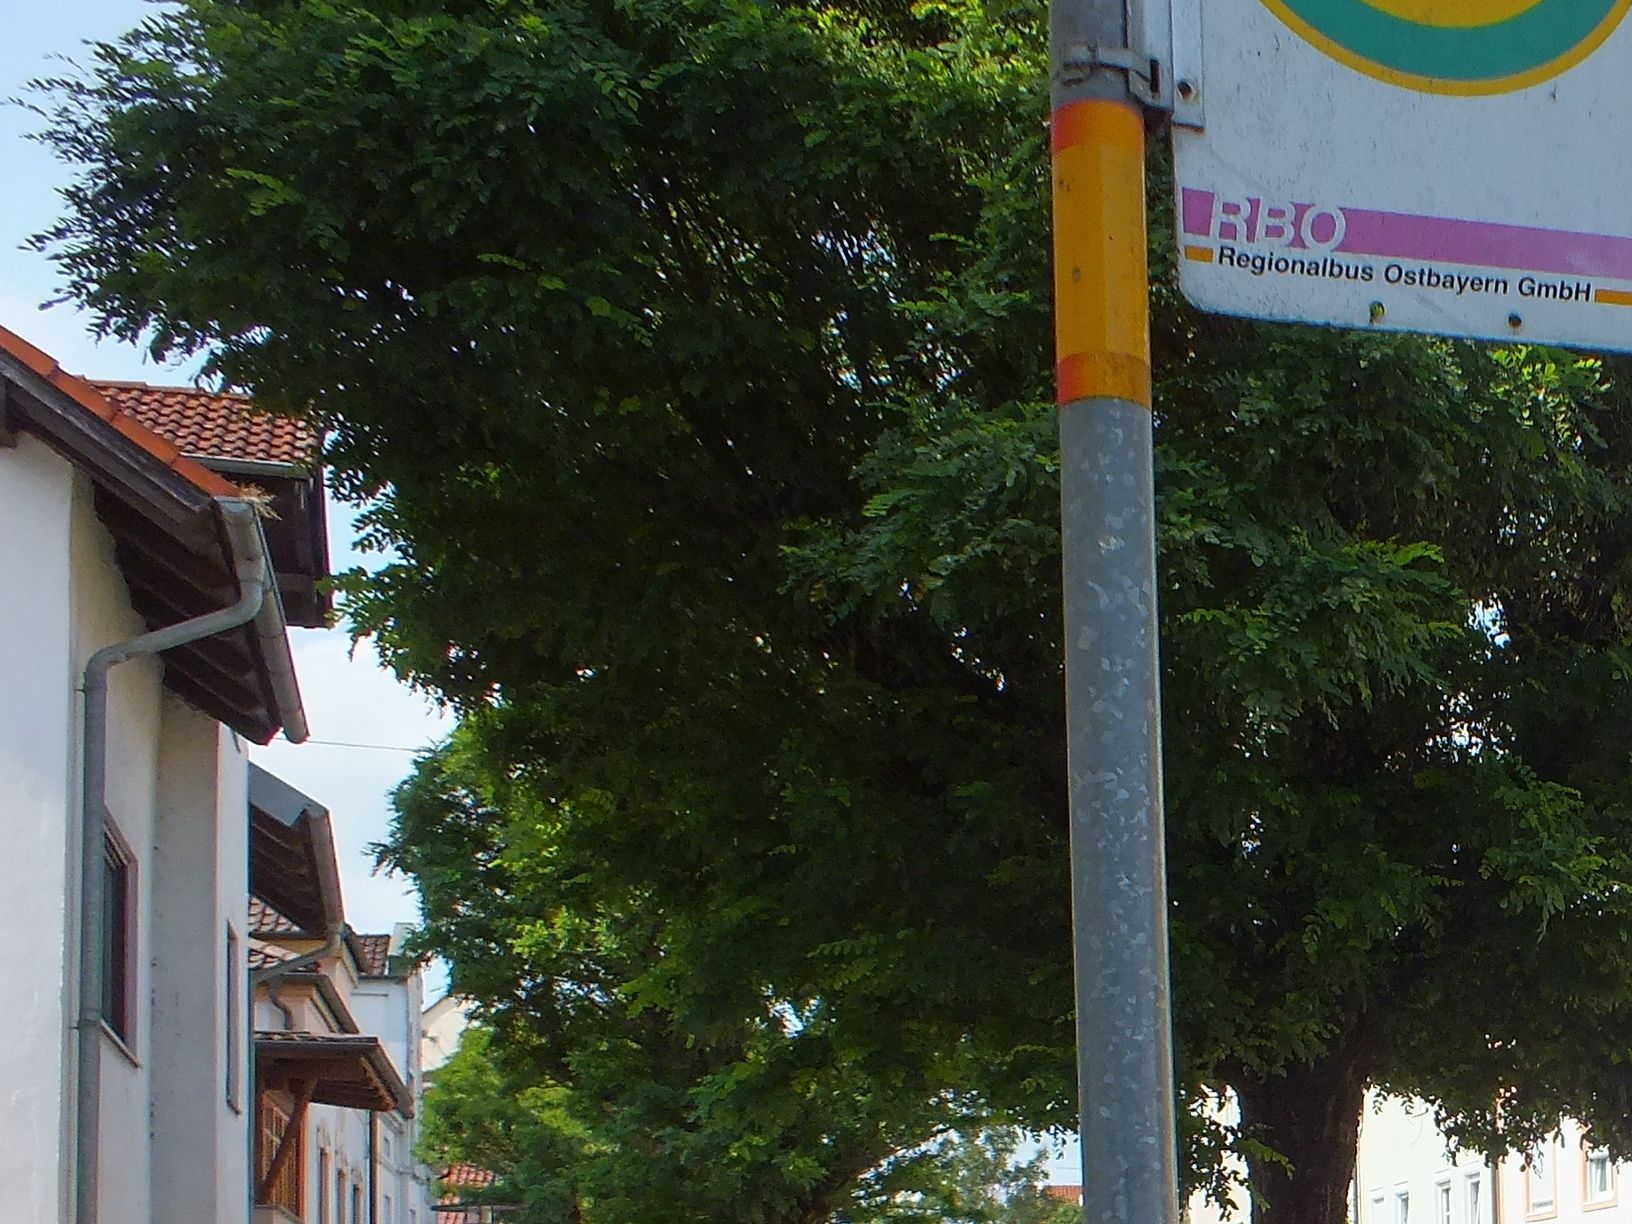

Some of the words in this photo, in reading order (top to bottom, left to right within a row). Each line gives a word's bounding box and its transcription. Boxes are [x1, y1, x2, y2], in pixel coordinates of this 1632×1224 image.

[1211, 197, 1346, 253] RBO
[1218, 246, 1373, 282] Regionalbus
[1384, 263, 1509, 296] Ostbayern
[1517, 276, 1592, 303] GmbH
